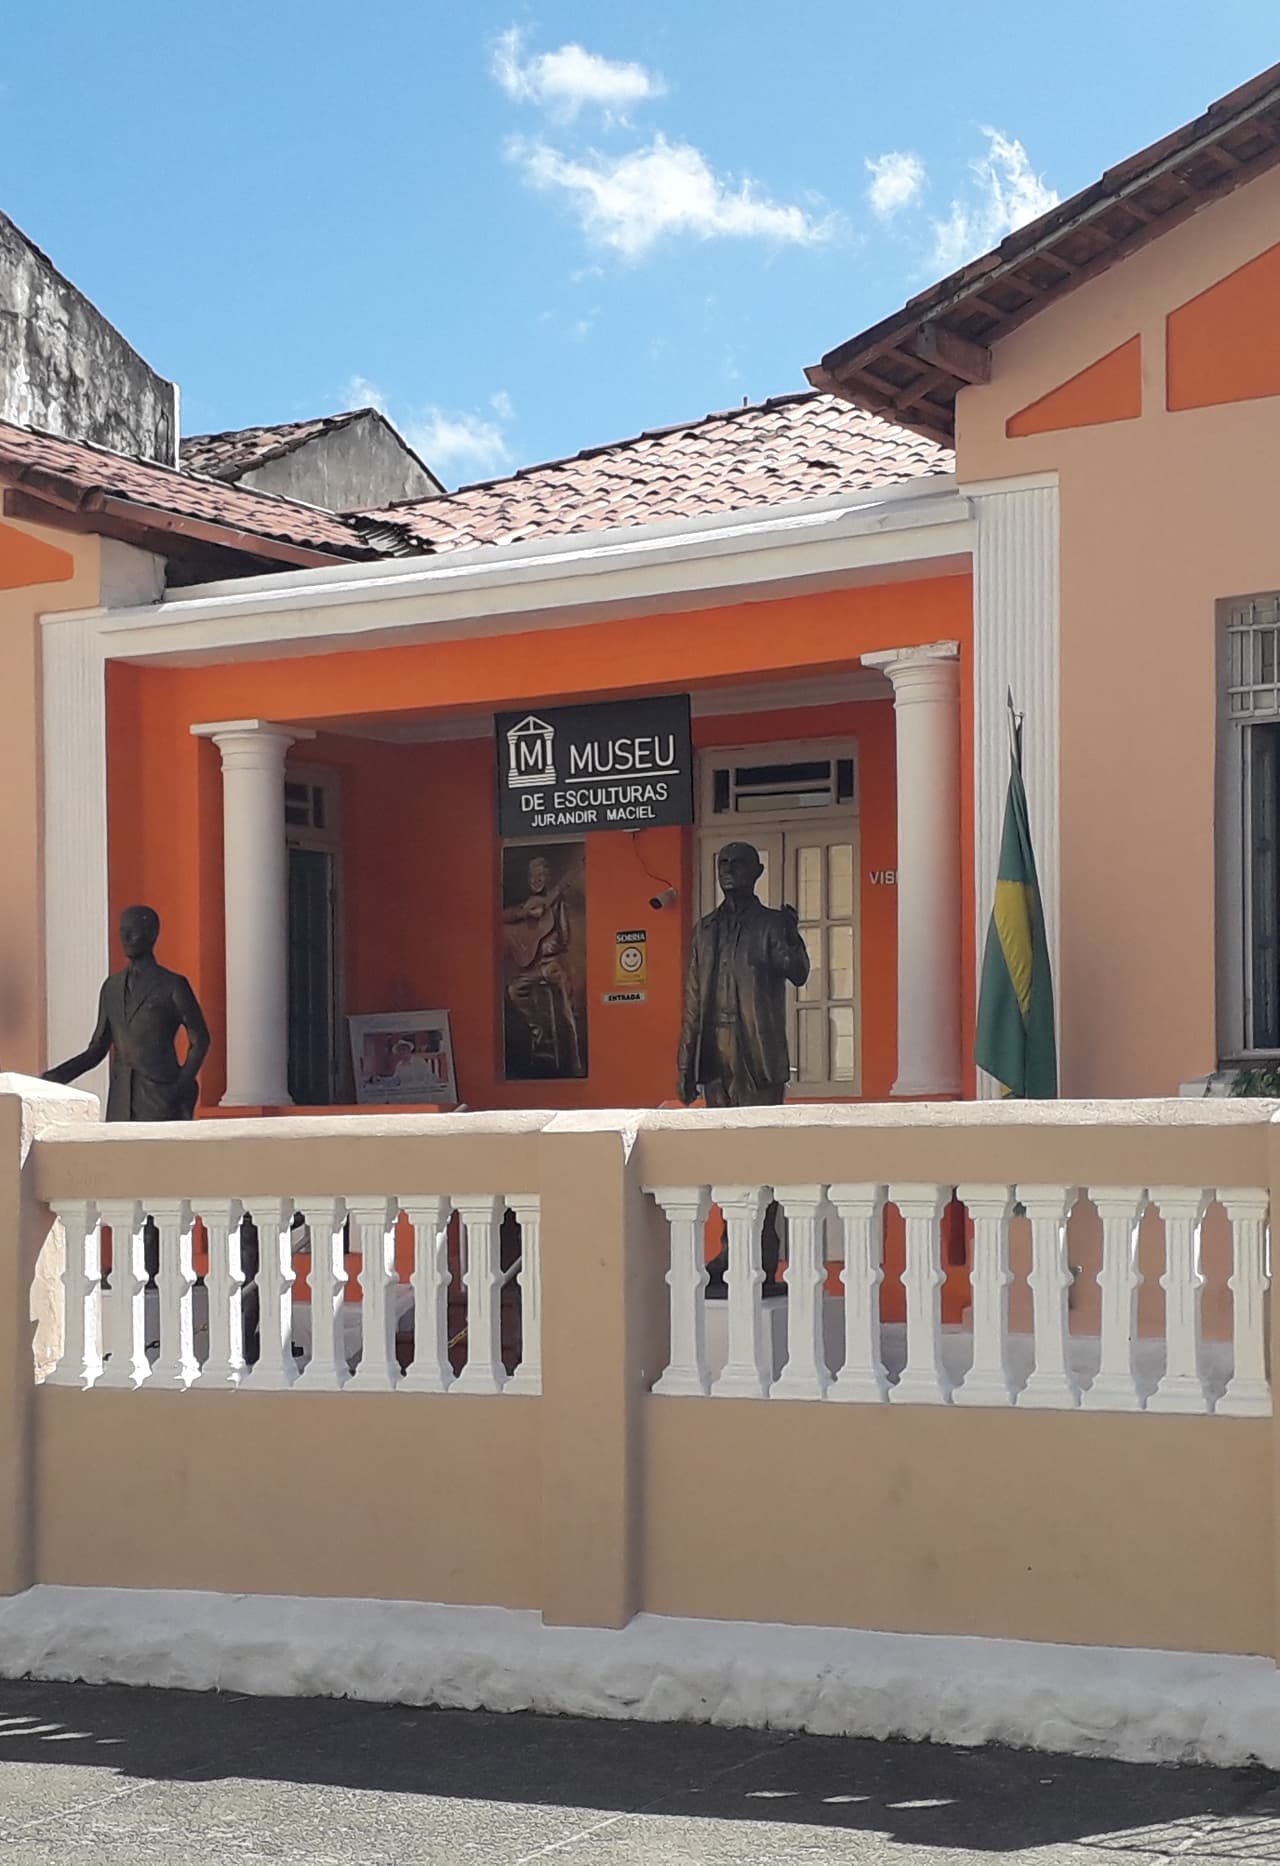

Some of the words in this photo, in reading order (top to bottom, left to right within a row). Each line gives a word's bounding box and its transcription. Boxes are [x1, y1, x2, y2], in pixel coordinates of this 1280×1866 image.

[569, 735, 675, 775] MUSEU
[521, 793, 545, 812] DE
[554, 782, 669, 809] ESCULTURAS
[531, 809, 598, 827] JURANDIR
[606, 805, 656, 822] MACIEL
